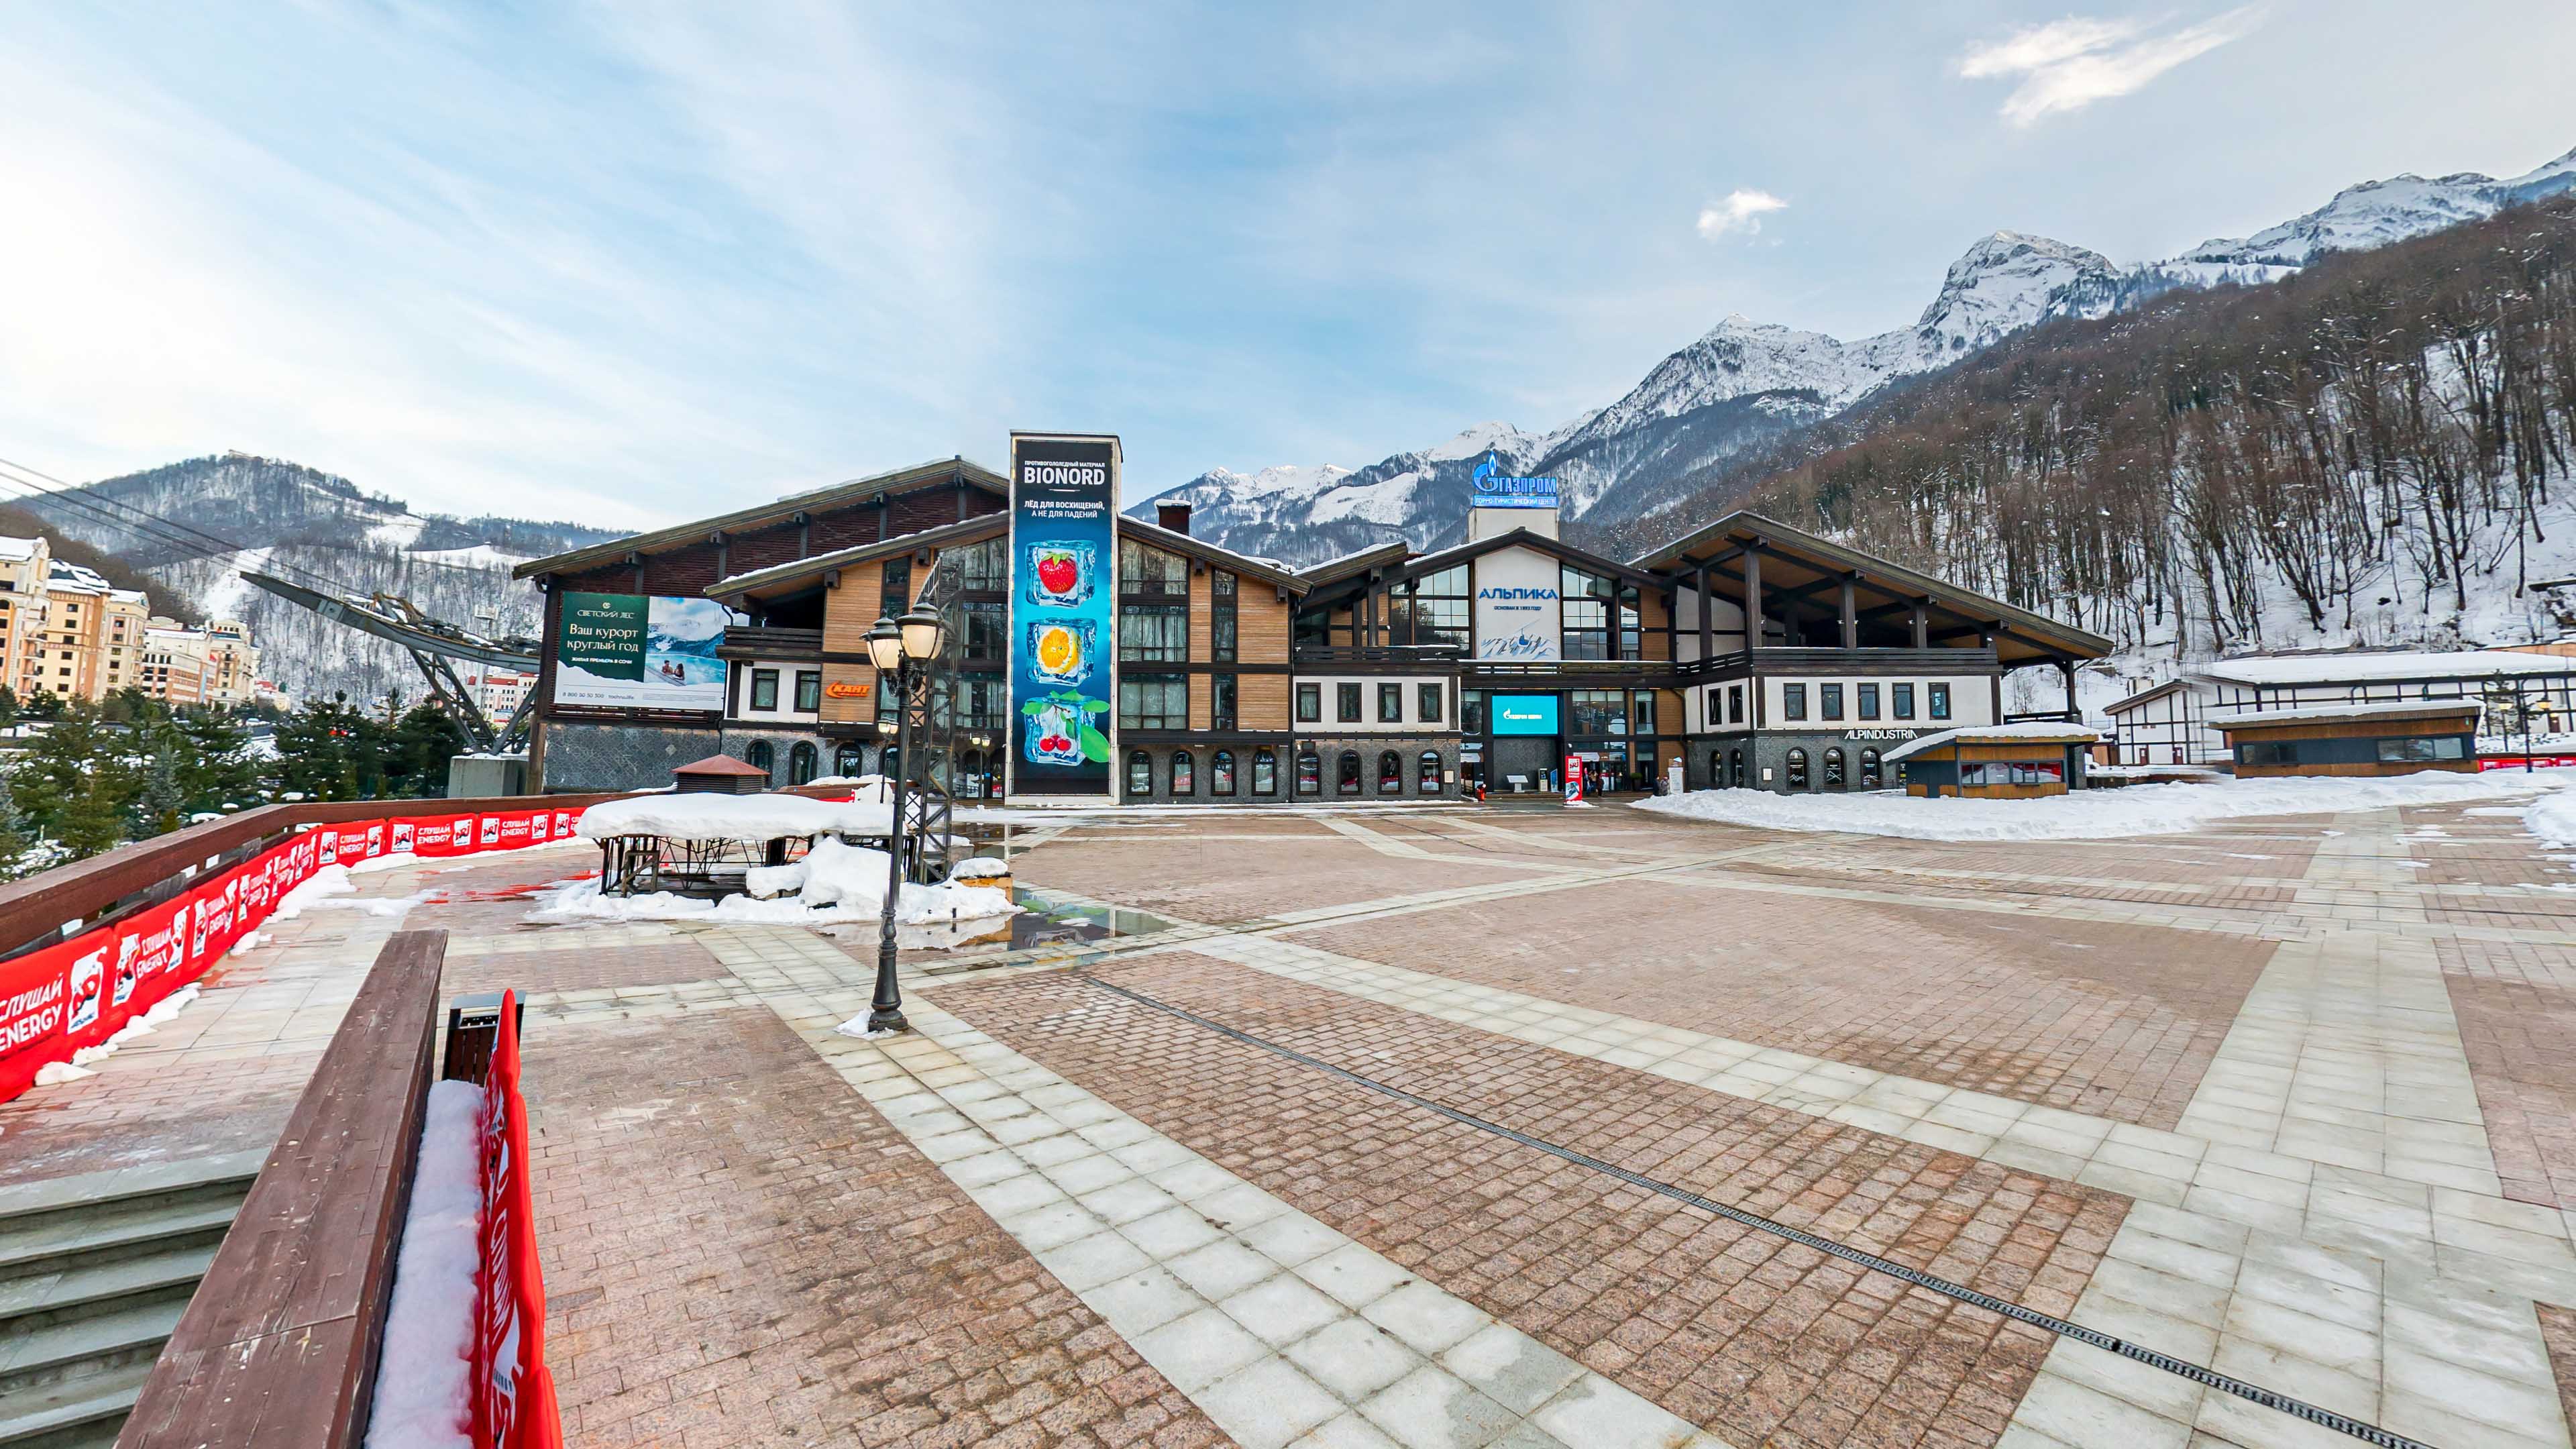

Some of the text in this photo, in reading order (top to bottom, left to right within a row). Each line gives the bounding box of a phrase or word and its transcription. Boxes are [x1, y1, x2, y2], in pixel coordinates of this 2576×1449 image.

[1024, 467, 1105, 485] BIONORD
[1499, 477, 1556, 493] ГАЗПРОМ
[1024, 500, 1105, 510] ЛЁД ДЛЯ ВОСХИЩЕНИЙ,
[1065, 510, 1097, 519] ПАДЕНИЙ
[1479, 588, 1558, 600] АЛЬПИКА
[577, 609, 619, 618] СВЕТСКИЙ
[570, 623, 639, 639] Ваш курорт
[567, 640, 639, 652] круглый год
[1845, 729, 1918, 740] ALPINDUSTRIA
[418, 824, 451, 835] СЛУШАЙ
[501, 826, 529, 837] ENERGY
[417, 835, 451, 845] ENERGY
[0, 972, 63, 1022] СЛУШАЙ
[0, 1002, 63, 1053] ENERGY
